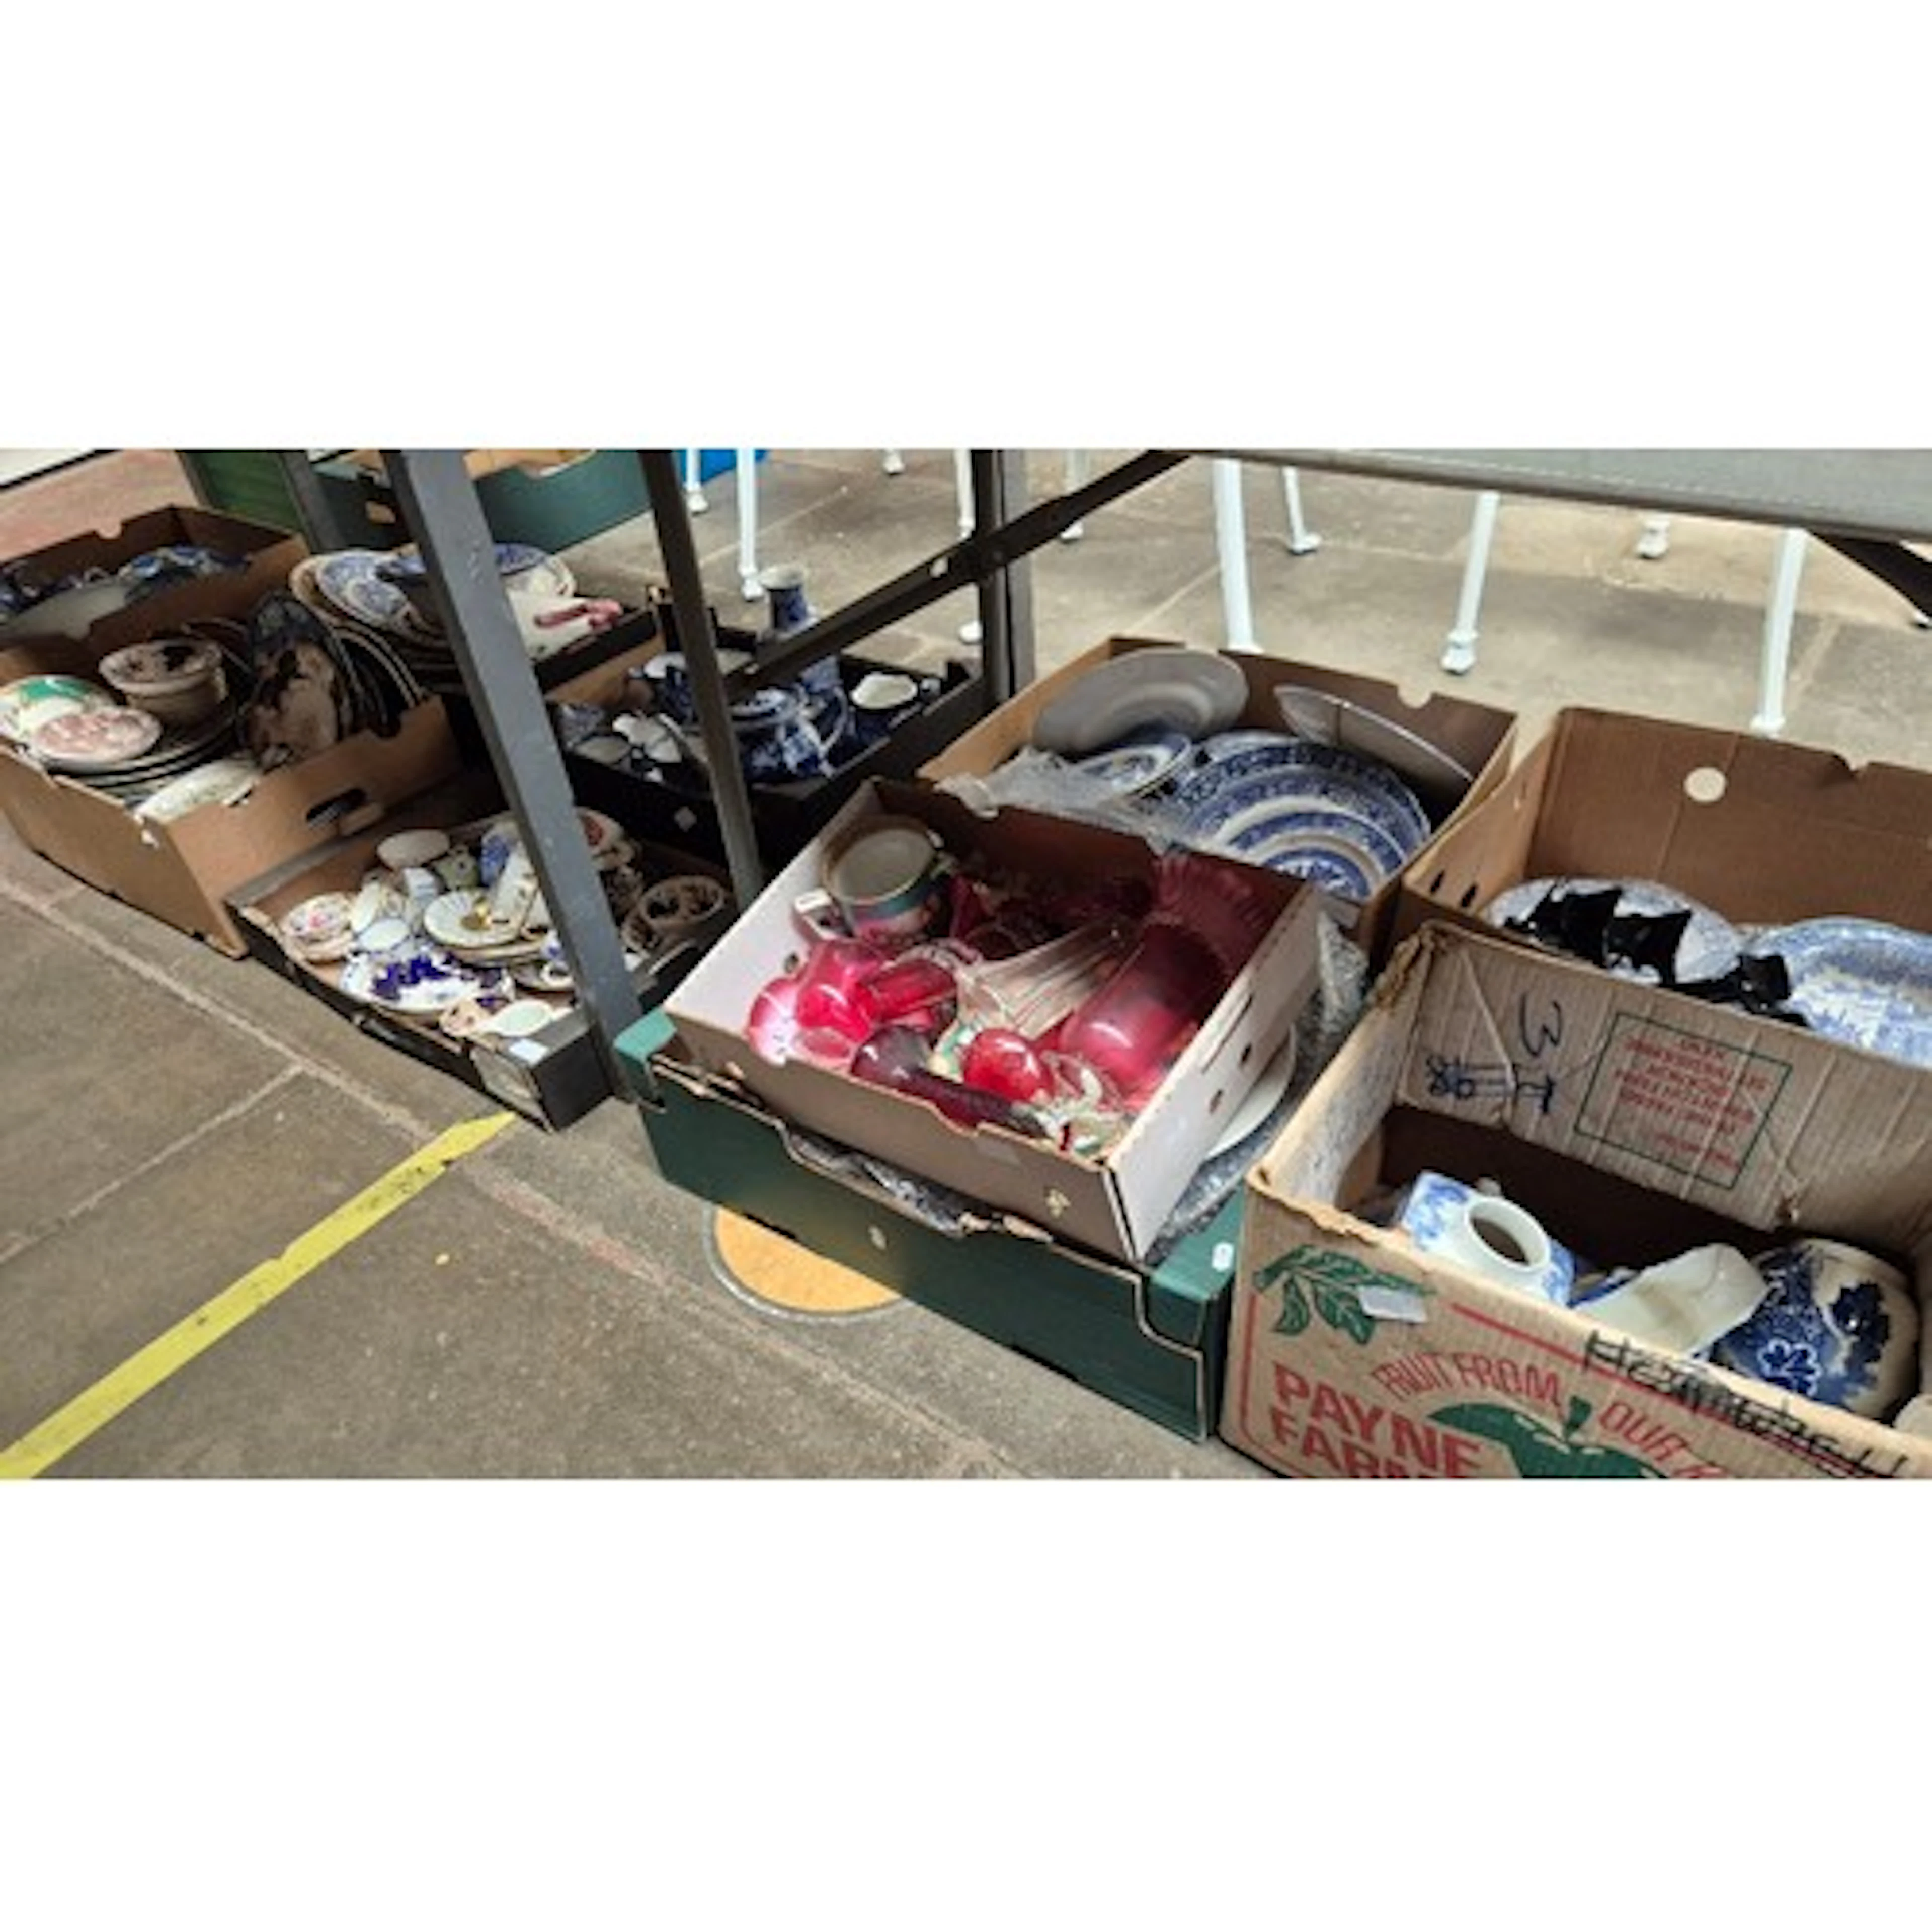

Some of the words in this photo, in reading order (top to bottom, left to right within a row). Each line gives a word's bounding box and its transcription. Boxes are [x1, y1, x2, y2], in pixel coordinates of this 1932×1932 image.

[1275, 1360, 1481, 1477] PAYNE
[1371, 1352, 1452, 1402] FRUIT
[1453, 1352, 1564, 1413] FROM
[1596, 1401, 1711, 1463] OUR
